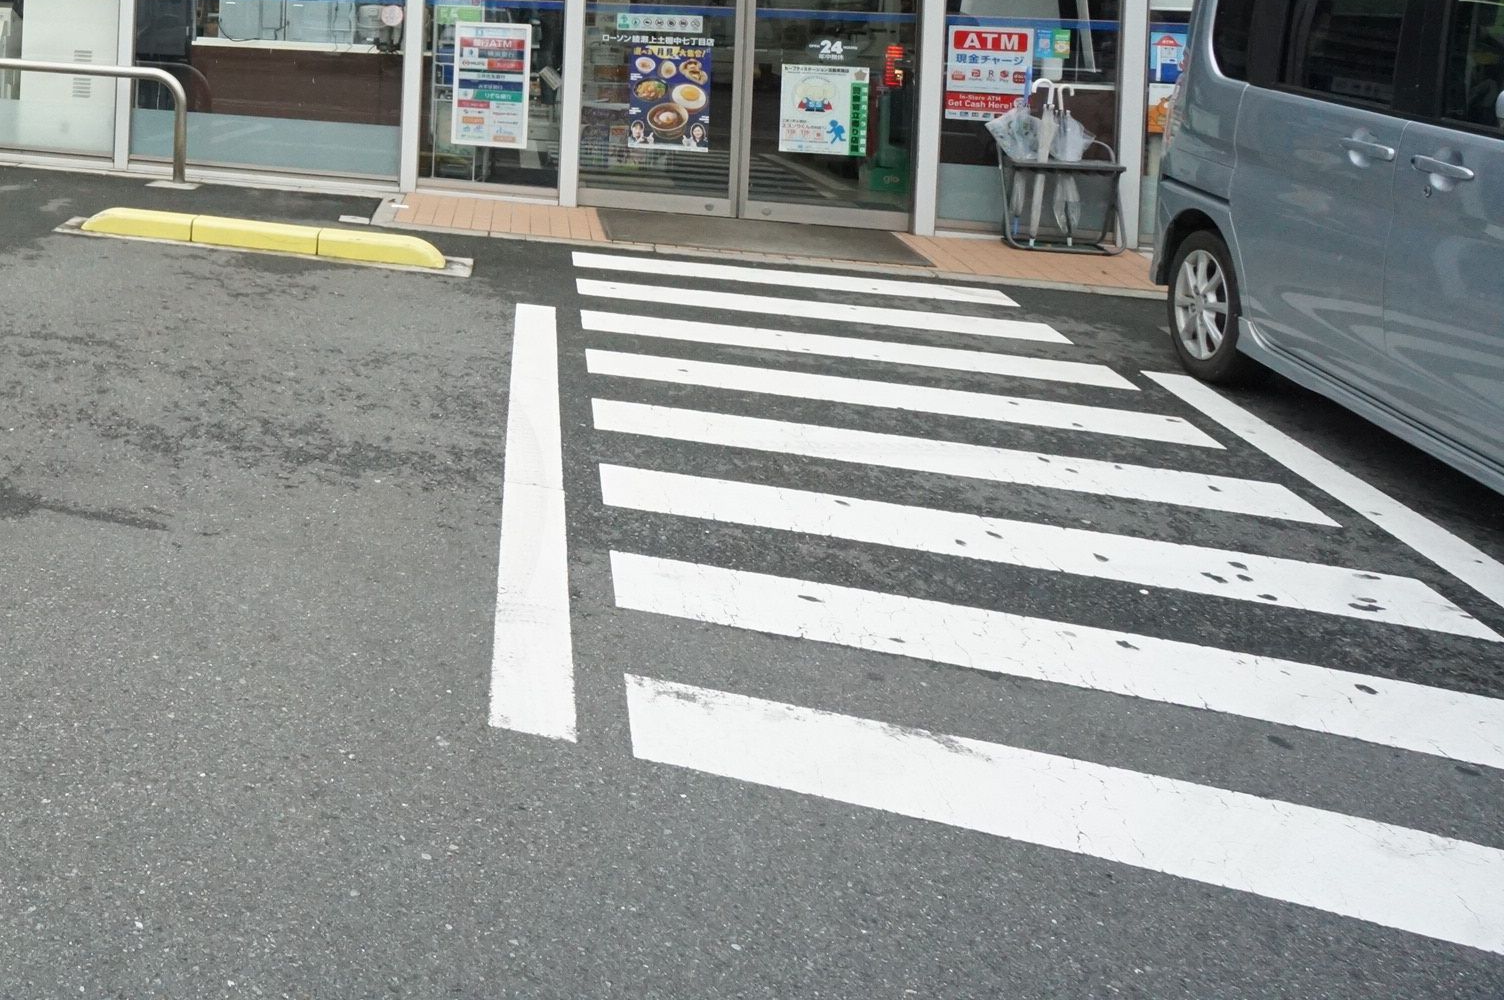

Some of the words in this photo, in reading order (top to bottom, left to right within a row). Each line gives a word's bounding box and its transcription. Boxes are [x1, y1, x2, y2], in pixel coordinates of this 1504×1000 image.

[820, 39, 844, 55] 24
[963, 32, 1020, 51] ATM
[956, 53, 1025, 66] 現金チャージ
[959, 93, 986, 101] In-Store
[948, 98, 962, 107] Get
[964, 99, 986, 109] Cash
[988, 101, 1012, 110] Here!
